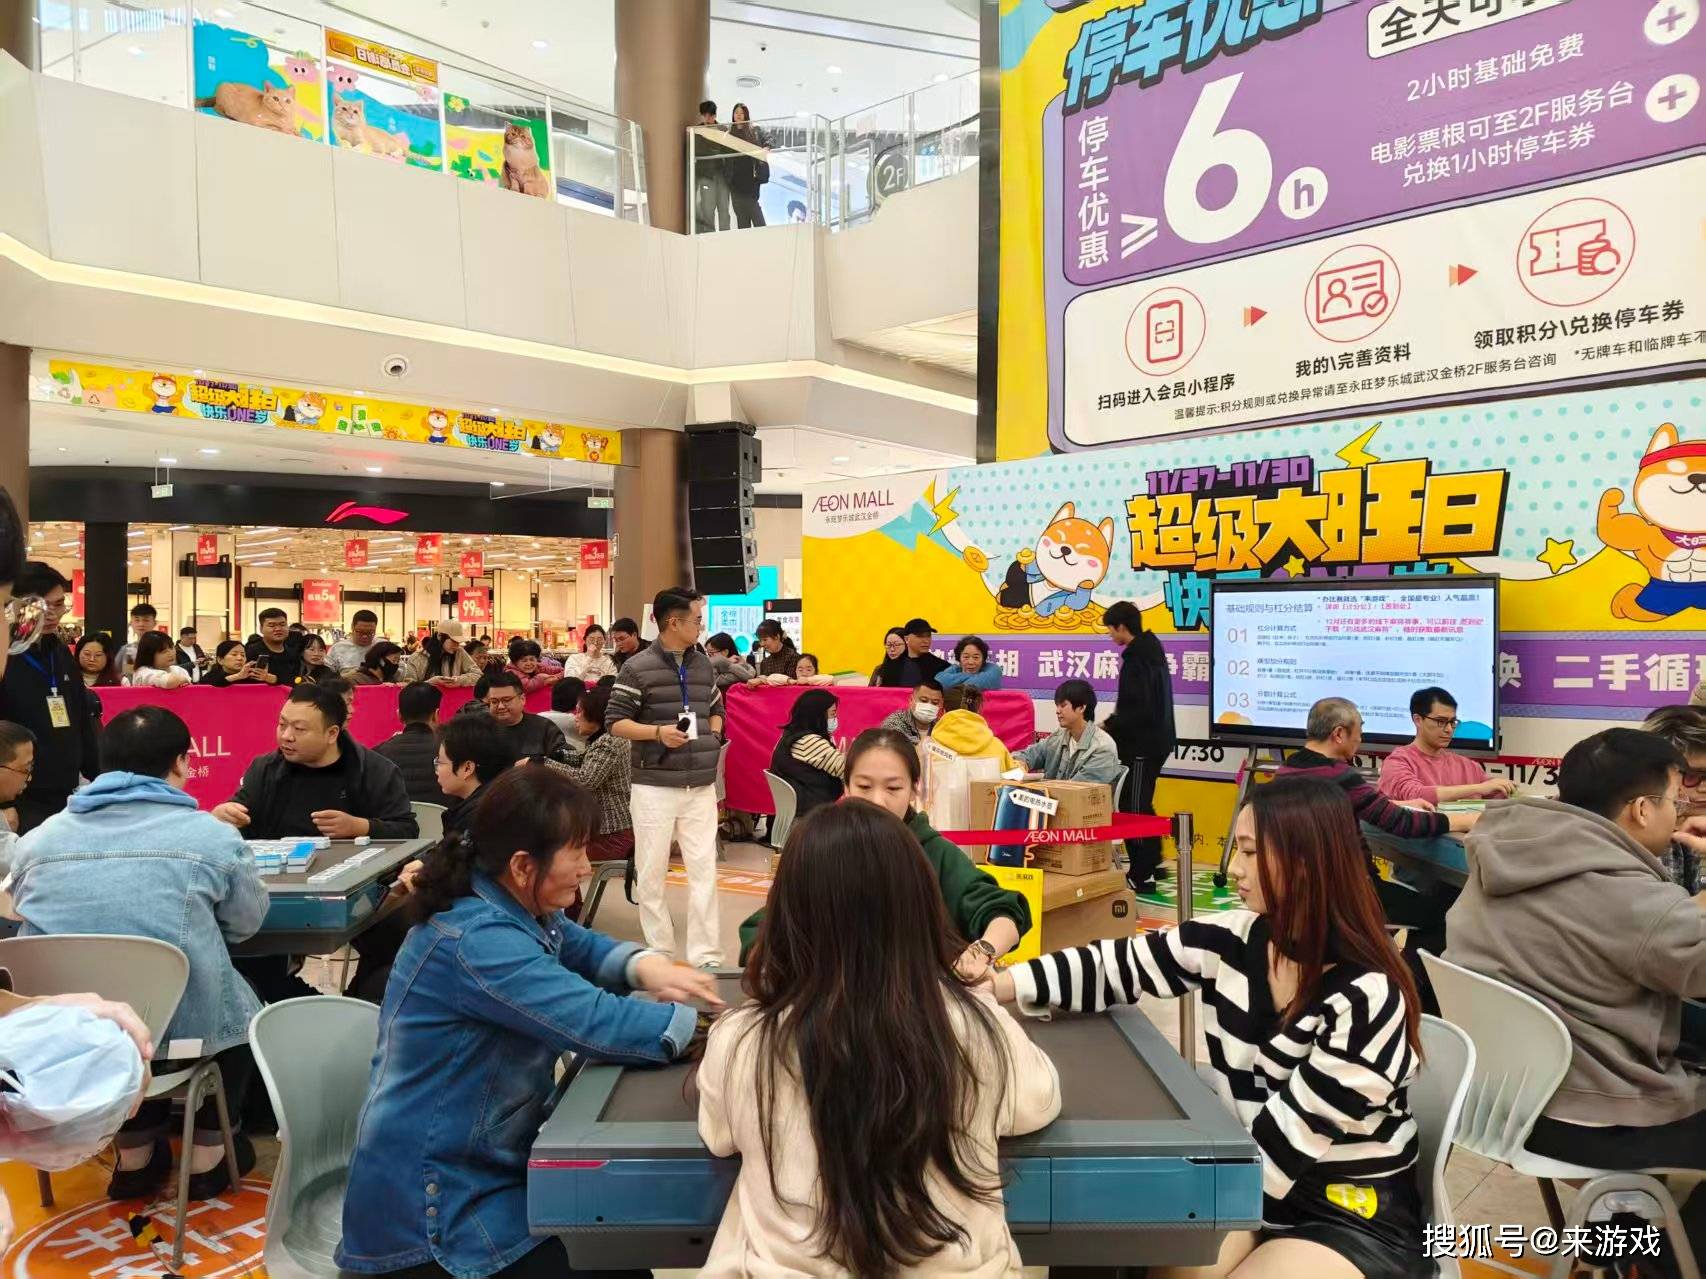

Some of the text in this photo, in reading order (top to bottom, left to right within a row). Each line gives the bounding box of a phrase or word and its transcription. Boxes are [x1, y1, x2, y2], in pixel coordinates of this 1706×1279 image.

[1407, 33, 1584, 101] 2小时基础免费
[1371, 81, 1634, 164] 电影票根可至2F服务台
[1402, 122, 1595, 187] 兑换1小时停车券
[883, 164, 904, 191] 2F
[1078, 116, 1109, 269] 停车优惠
[1474, 299, 1685, 350] 领取积分\兑换停车券
[1295, 342, 1411, 378] 我的\完善资料
[1097, 373, 1235, 410] 扫码进入会员小程序
[1146, 455, 1314, 495] 11/27-11/30
[853, 489, 894, 509] MALL
[1125, 457, 1507, 572] 超级大旺日
[1227, 627, 1248, 643] 01
[1227, 660, 1249, 676] 02
[1227, 692, 1249, 708] 03
[187, 736, 231, 758] ALL
[1063, 829, 1098, 842] MALL
